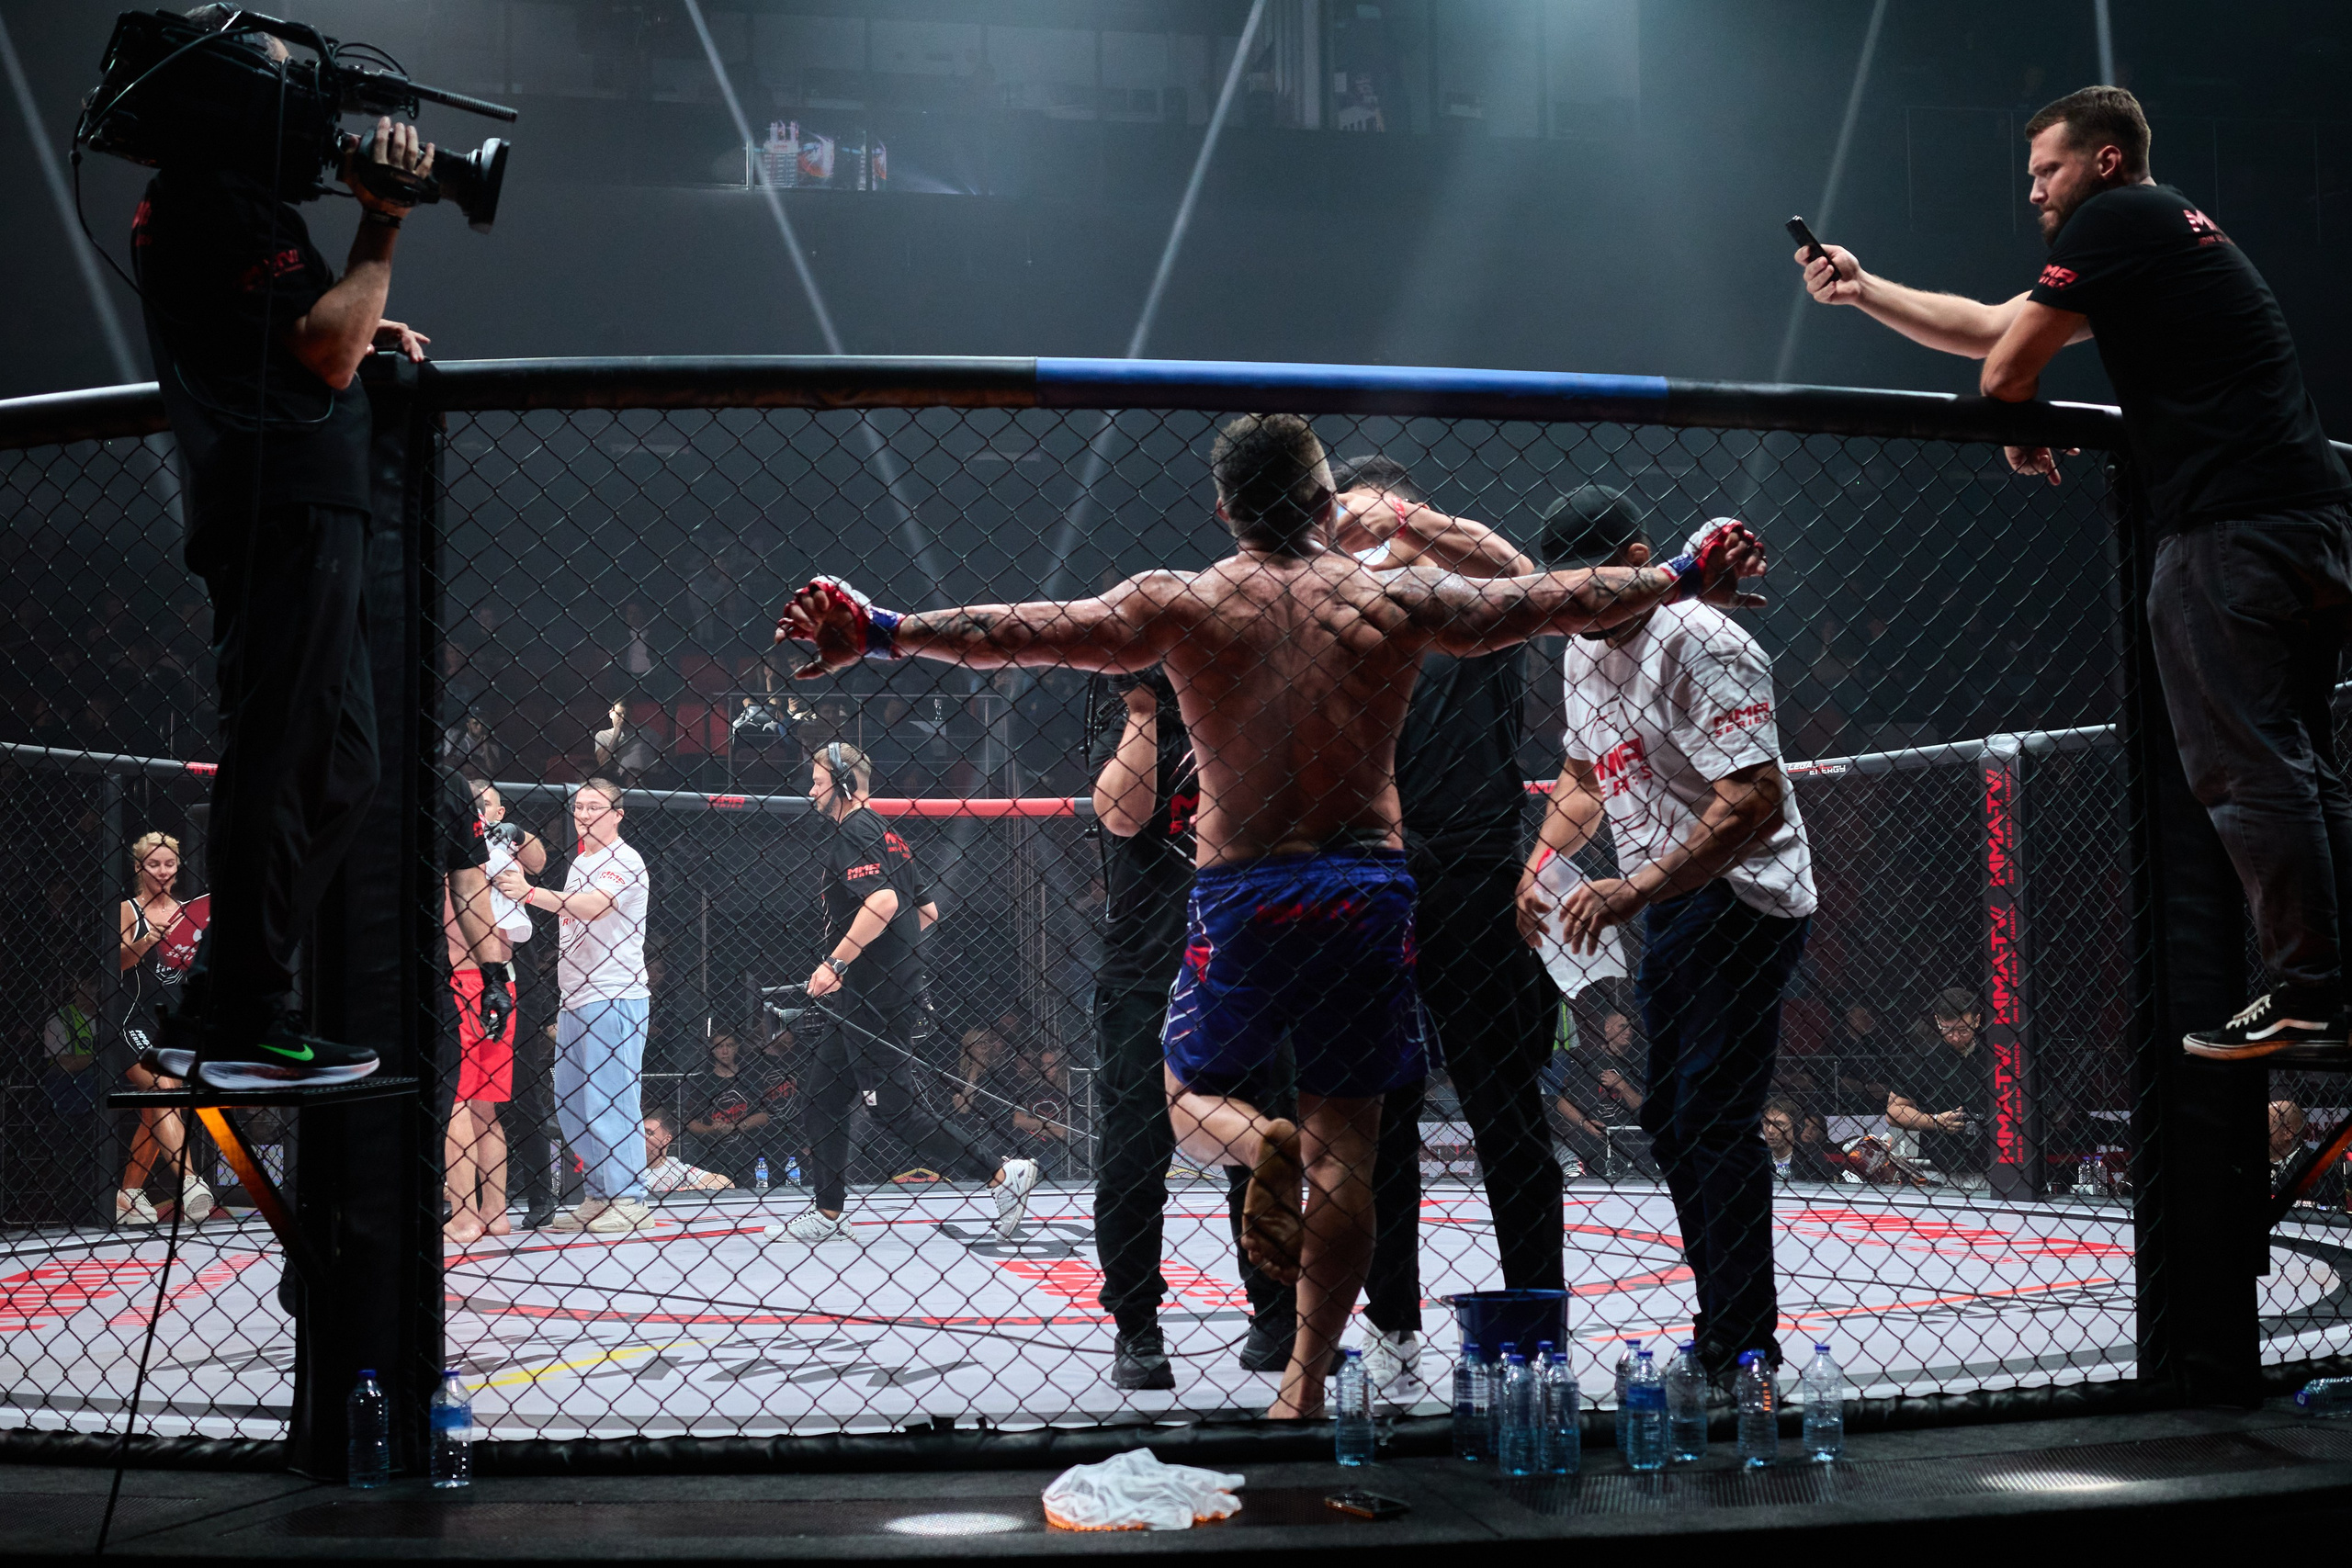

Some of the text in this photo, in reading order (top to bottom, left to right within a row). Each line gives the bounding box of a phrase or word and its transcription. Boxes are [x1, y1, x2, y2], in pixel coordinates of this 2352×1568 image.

[2042, 264, 2078, 283] MA
[847, 863, 880, 875] MMA
[847, 869, 880, 881] SERIES
